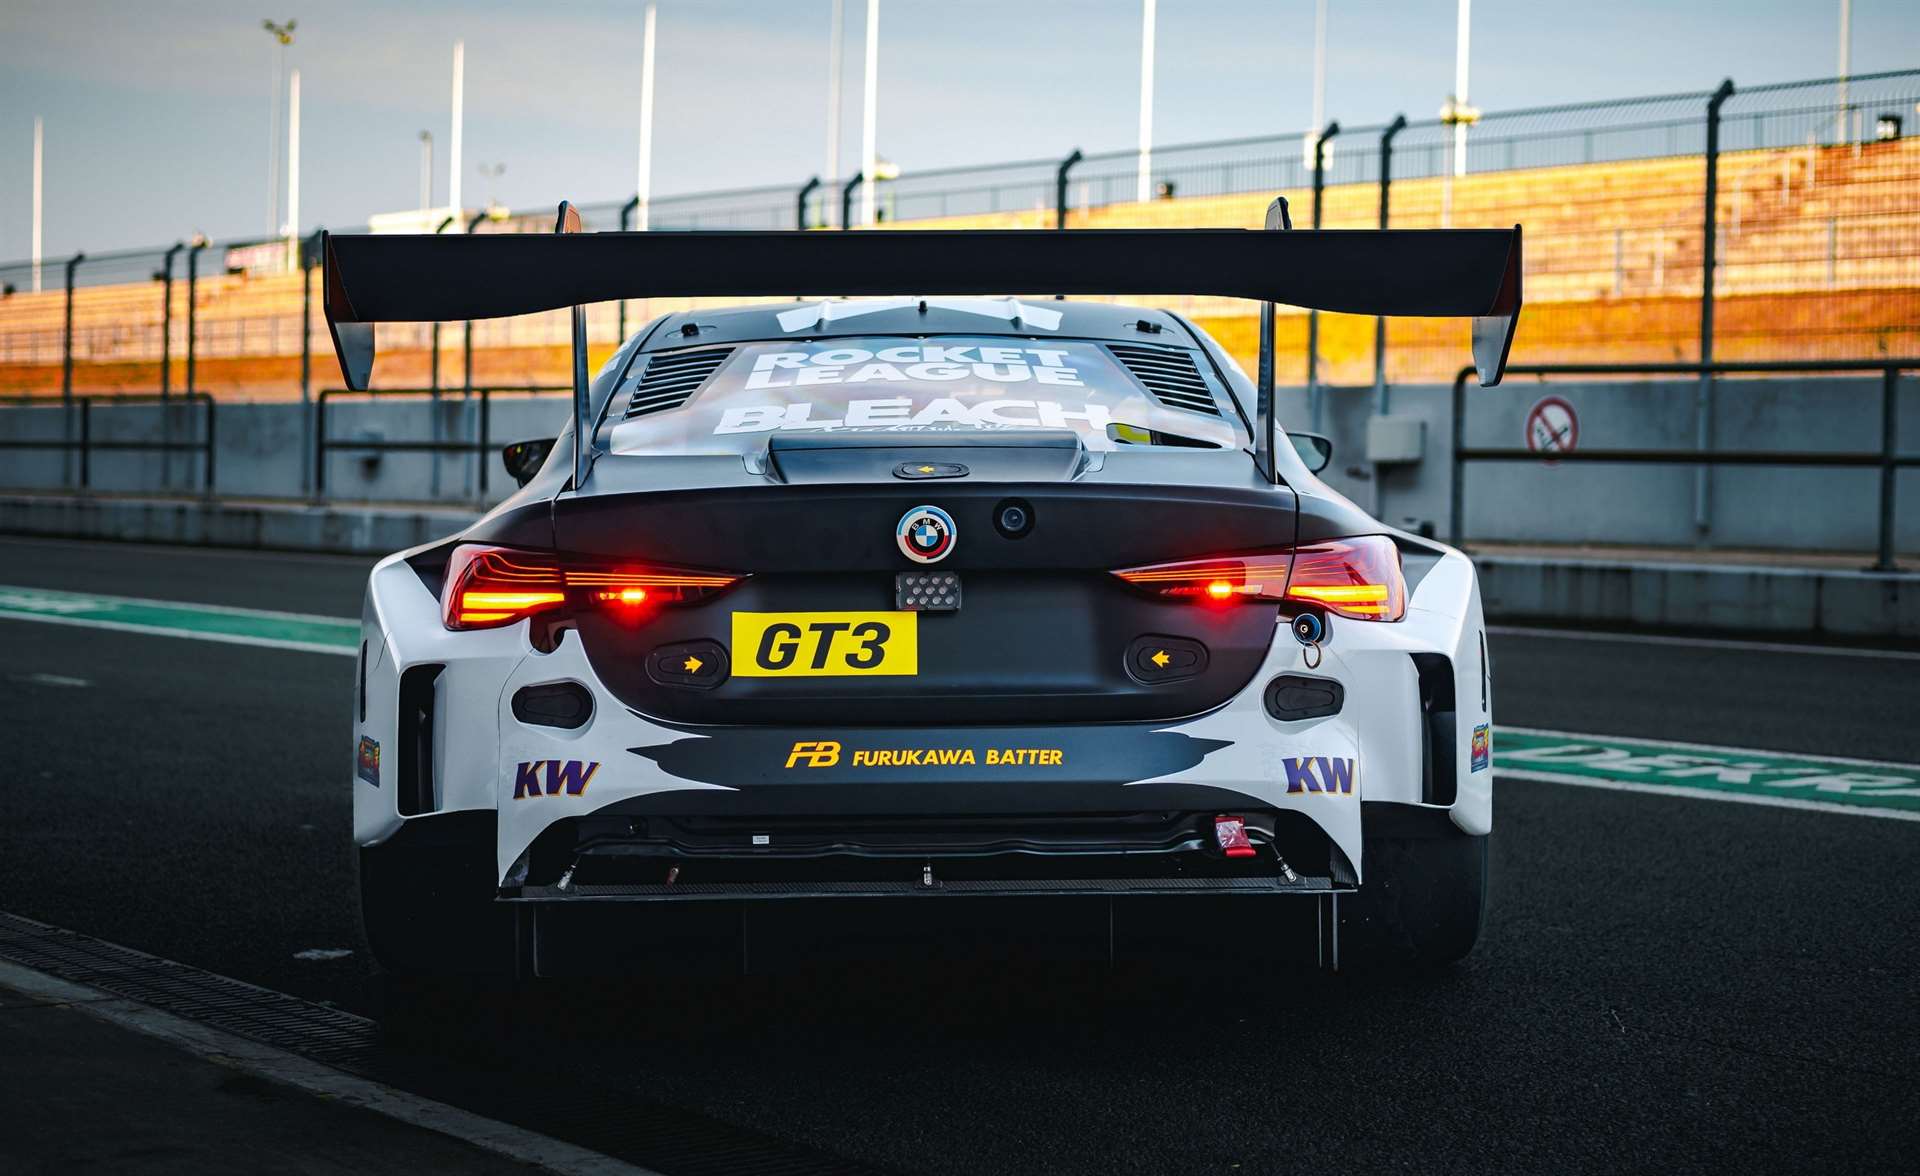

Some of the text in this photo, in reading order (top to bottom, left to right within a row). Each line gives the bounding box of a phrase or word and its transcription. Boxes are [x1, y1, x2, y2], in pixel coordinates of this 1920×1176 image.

[744, 363, 1086, 390] LEAGUE
[756, 346, 1070, 372] ROCKET
[715, 397, 1112, 433] BLEACH
[911, 518, 943, 531] BMW
[755, 621, 892, 671] GT3
[852, 749, 976, 766] FURUKAWA
[985, 749, 1064, 766] BATTER
[1281, 755, 1356, 796] KW
[1493, 743, 1920, 798] DEKR
[513, 759, 601, 800] KW
